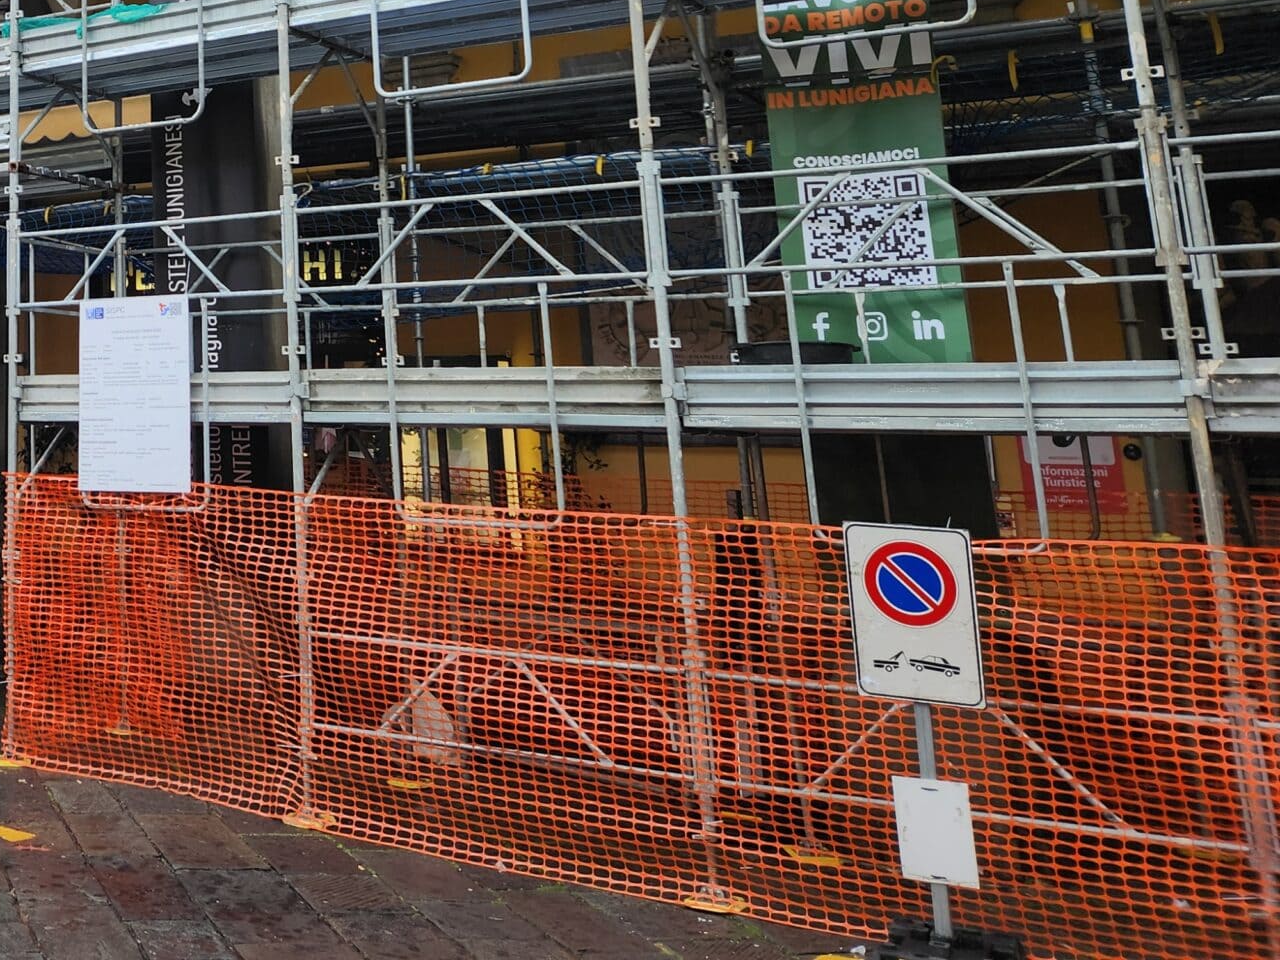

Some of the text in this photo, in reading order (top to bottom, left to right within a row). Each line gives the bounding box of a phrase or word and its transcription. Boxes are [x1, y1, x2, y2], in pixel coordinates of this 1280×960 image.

[764, 13, 803, 35] DA
[767, 21, 933, 87] VIVI
[767, 77, 934, 110] IN LUNIGIANA
[165, 114, 188, 293] STELE LUNIGIANESI
[1039, 465, 1109, 478] nformazoni
[1044, 477, 1101, 488] Turistice
